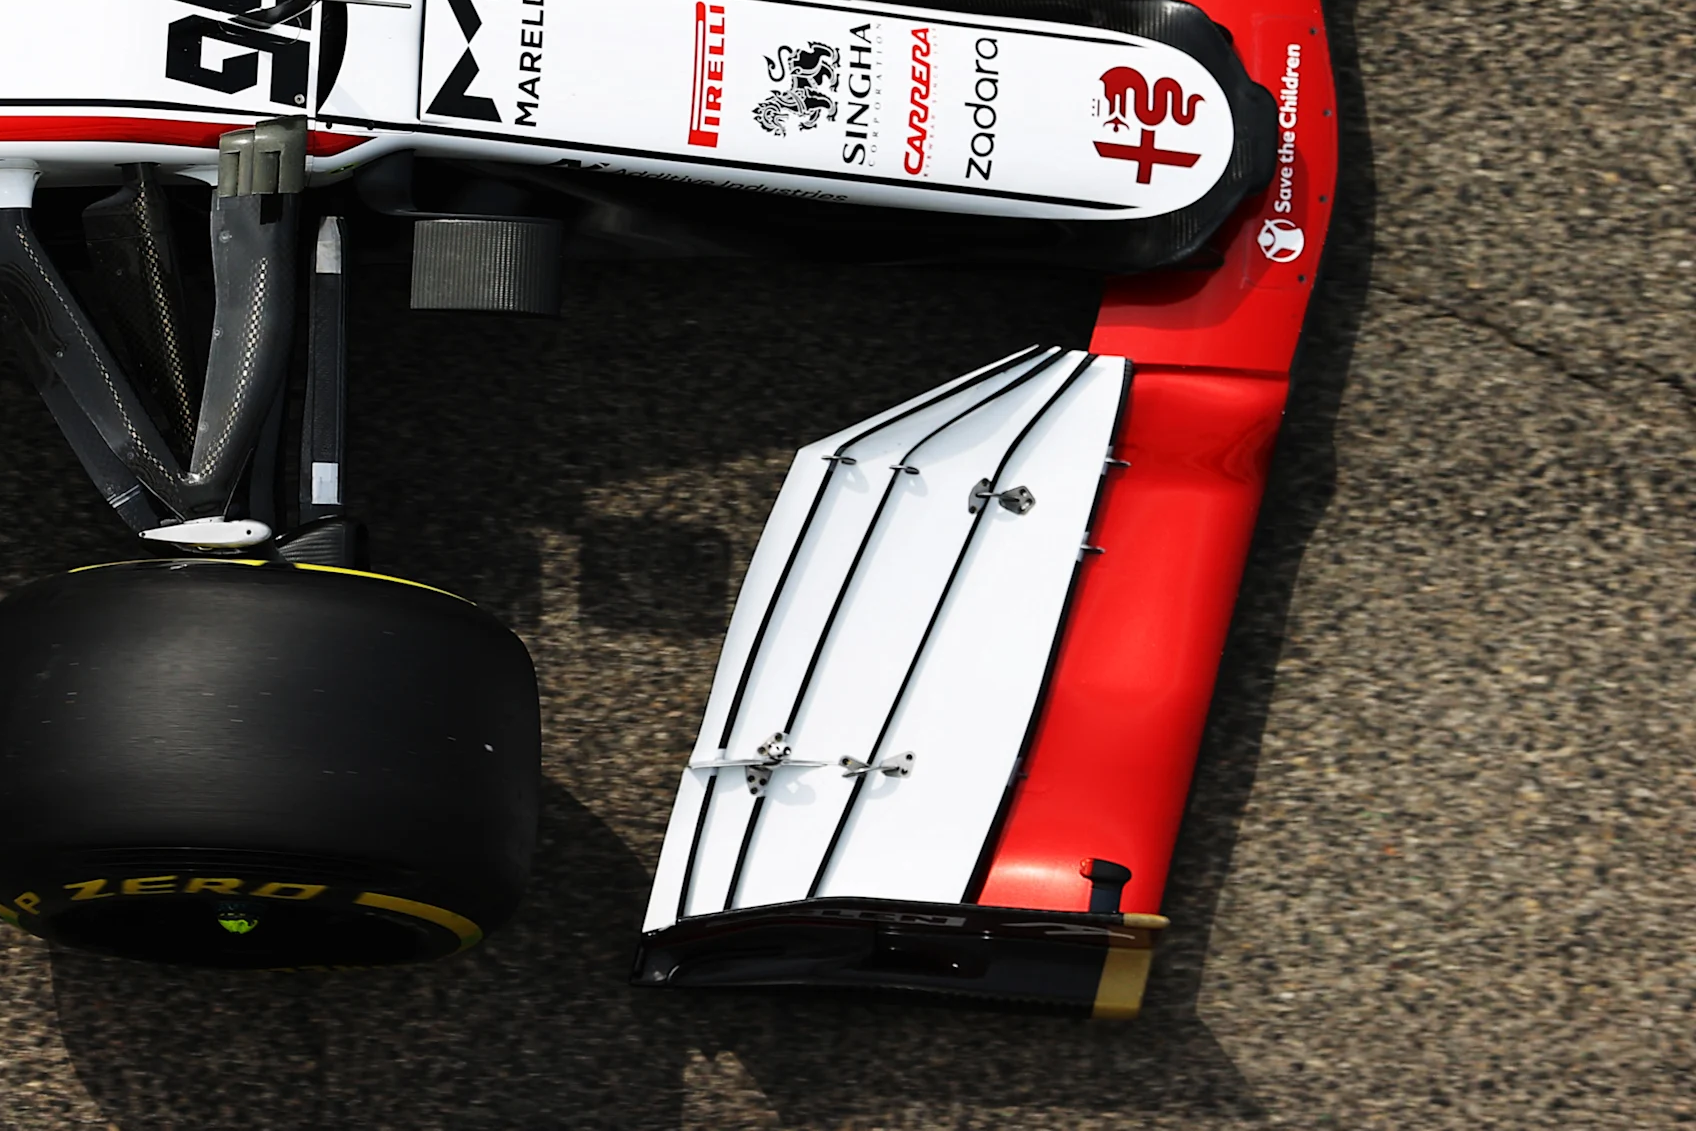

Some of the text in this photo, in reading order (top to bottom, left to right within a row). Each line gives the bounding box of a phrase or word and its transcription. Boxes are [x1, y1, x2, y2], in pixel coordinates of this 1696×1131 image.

[688, 1, 725, 148] PIRELLI
[842, 23, 872, 166] SINGHA
[868, 22, 883, 167] CORPORATION
[903, 28, 931, 175] CARRERA
[964, 37, 999, 181] zadara
[1274, 43, 1302, 213] Save the Children
[719, 179, 849, 202] Industries
[62, 875, 329, 901] ZERO
